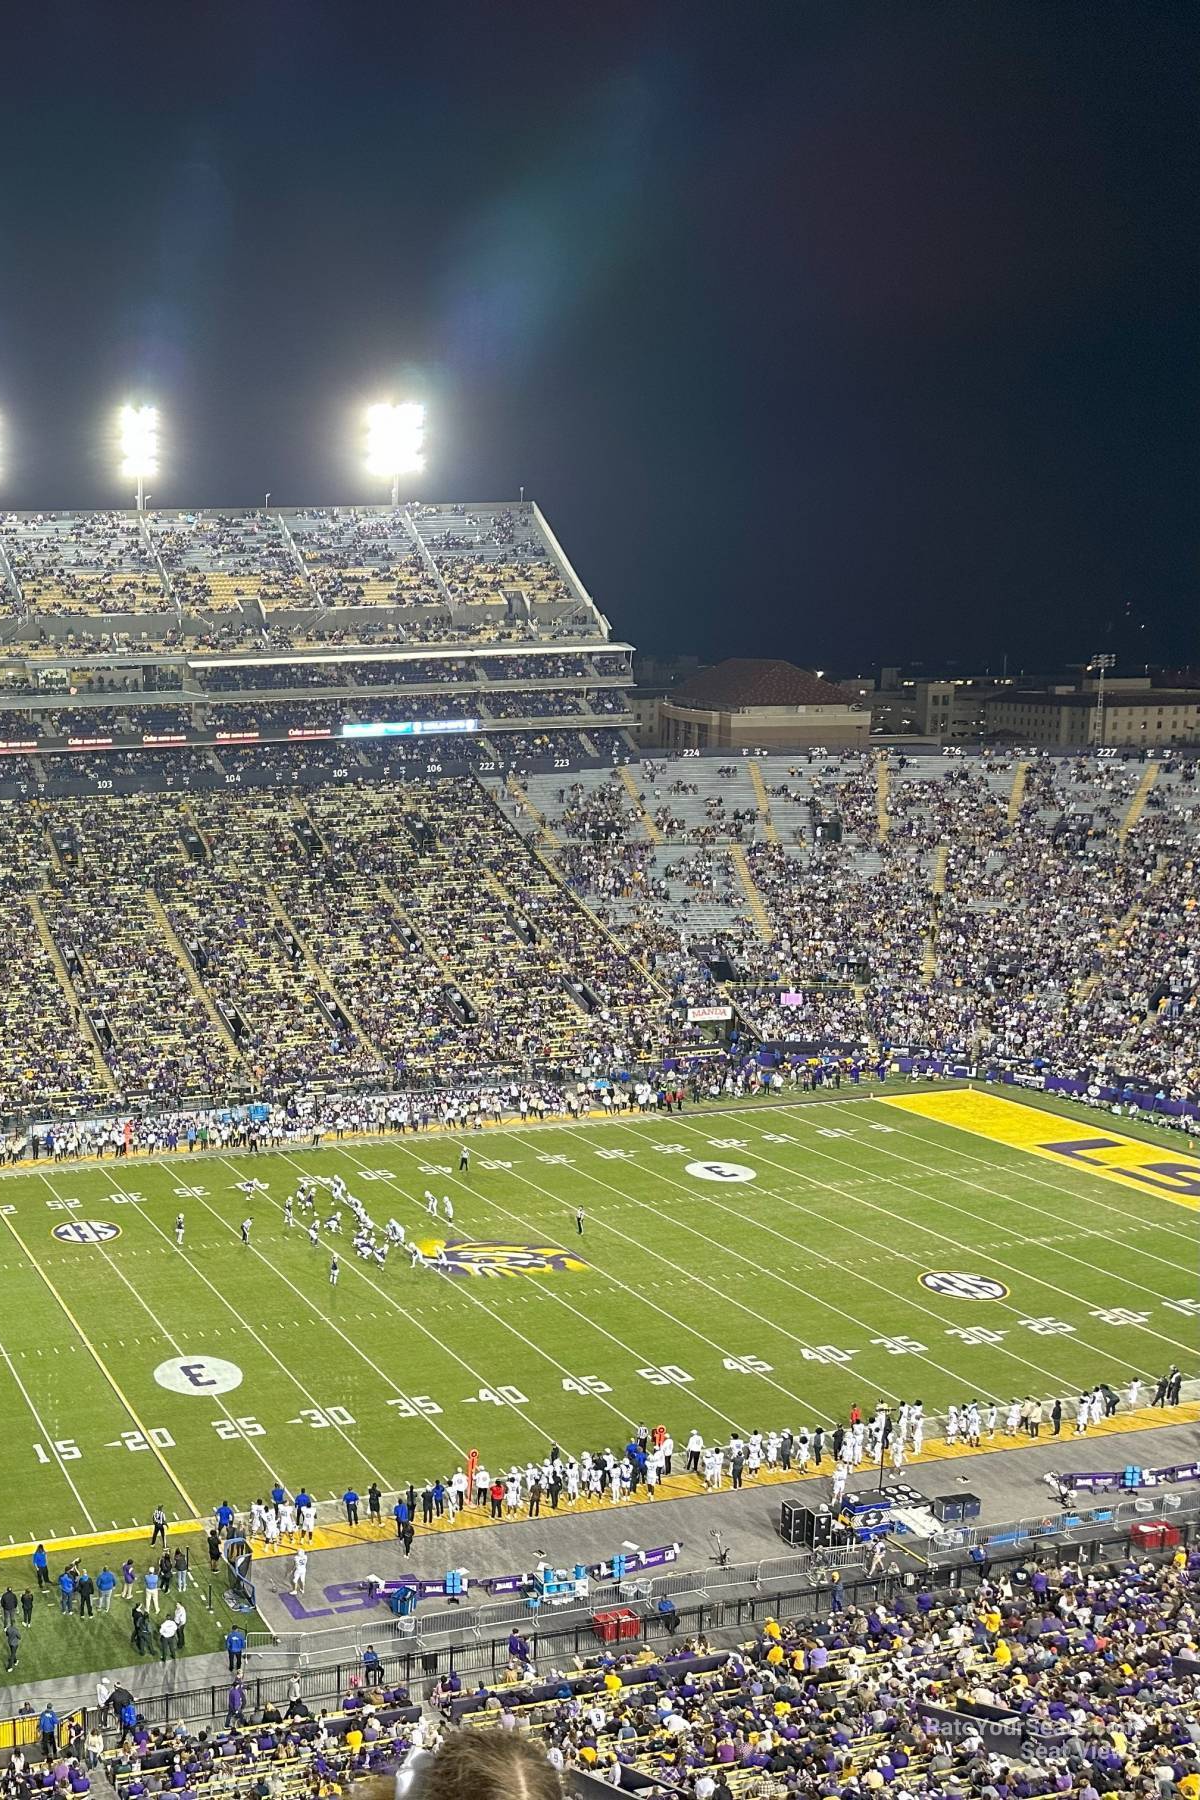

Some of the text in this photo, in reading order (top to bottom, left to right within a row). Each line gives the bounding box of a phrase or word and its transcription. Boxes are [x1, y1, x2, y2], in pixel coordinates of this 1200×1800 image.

[683, 749, 699, 757] 224
[1097, 748, 1117, 757] 227
[426, 764, 442, 773] 106
[479, 762, 495, 770] 222
[554, 759, 570, 767] 223
[225, 774, 241, 783] 104
[332, 769, 348, 777] 105
[97, 780, 113, 789] 103
[692, 1008, 727, 1018] MANDA
[816, 1128, 855, 1138] 10
[869, 1123, 895, 1133] 5
[706, 1139, 749, 1150] 20
[761, 1133, 800, 1144] 15
[595, 1148, 636, 1160] 30
[651, 1143, 692, 1155] 25
[477, 1159, 513, 1170] 40
[536, 1153, 577, 1165] 35
[356, 1168, 397, 1181] 50
[417, 1164, 453, 1175] 45
[172, 1186, 212, 1198] 35
[45, 1198, 84, 1211] 25
[109, 1192, 148, 1205] 30
[56, 1220, 120, 1243] SEC
[924, 1271, 1004, 1300] SEC
[1088, 1307, 1150, 1326] 20
[1017, 1316, 1077, 1335] 25
[944, 1326, 1005, 1345] 30
[869, 1335, 929, 1355] 35
[800, 1344, 853, 1364] 40
[722, 1354, 775, 1375] 45
[635, 1365, 696, 1386] 50
[561, 1375, 615, 1396] 45
[477, 1385, 531, 1406] 40
[385, 1395, 445, 1418] 35
[300, 1406, 357, 1429] 30
[211, 1416, 268, 1441] 25
[120, 1427, 178, 1452] 20
[32, 1439, 83, 1464] 15
